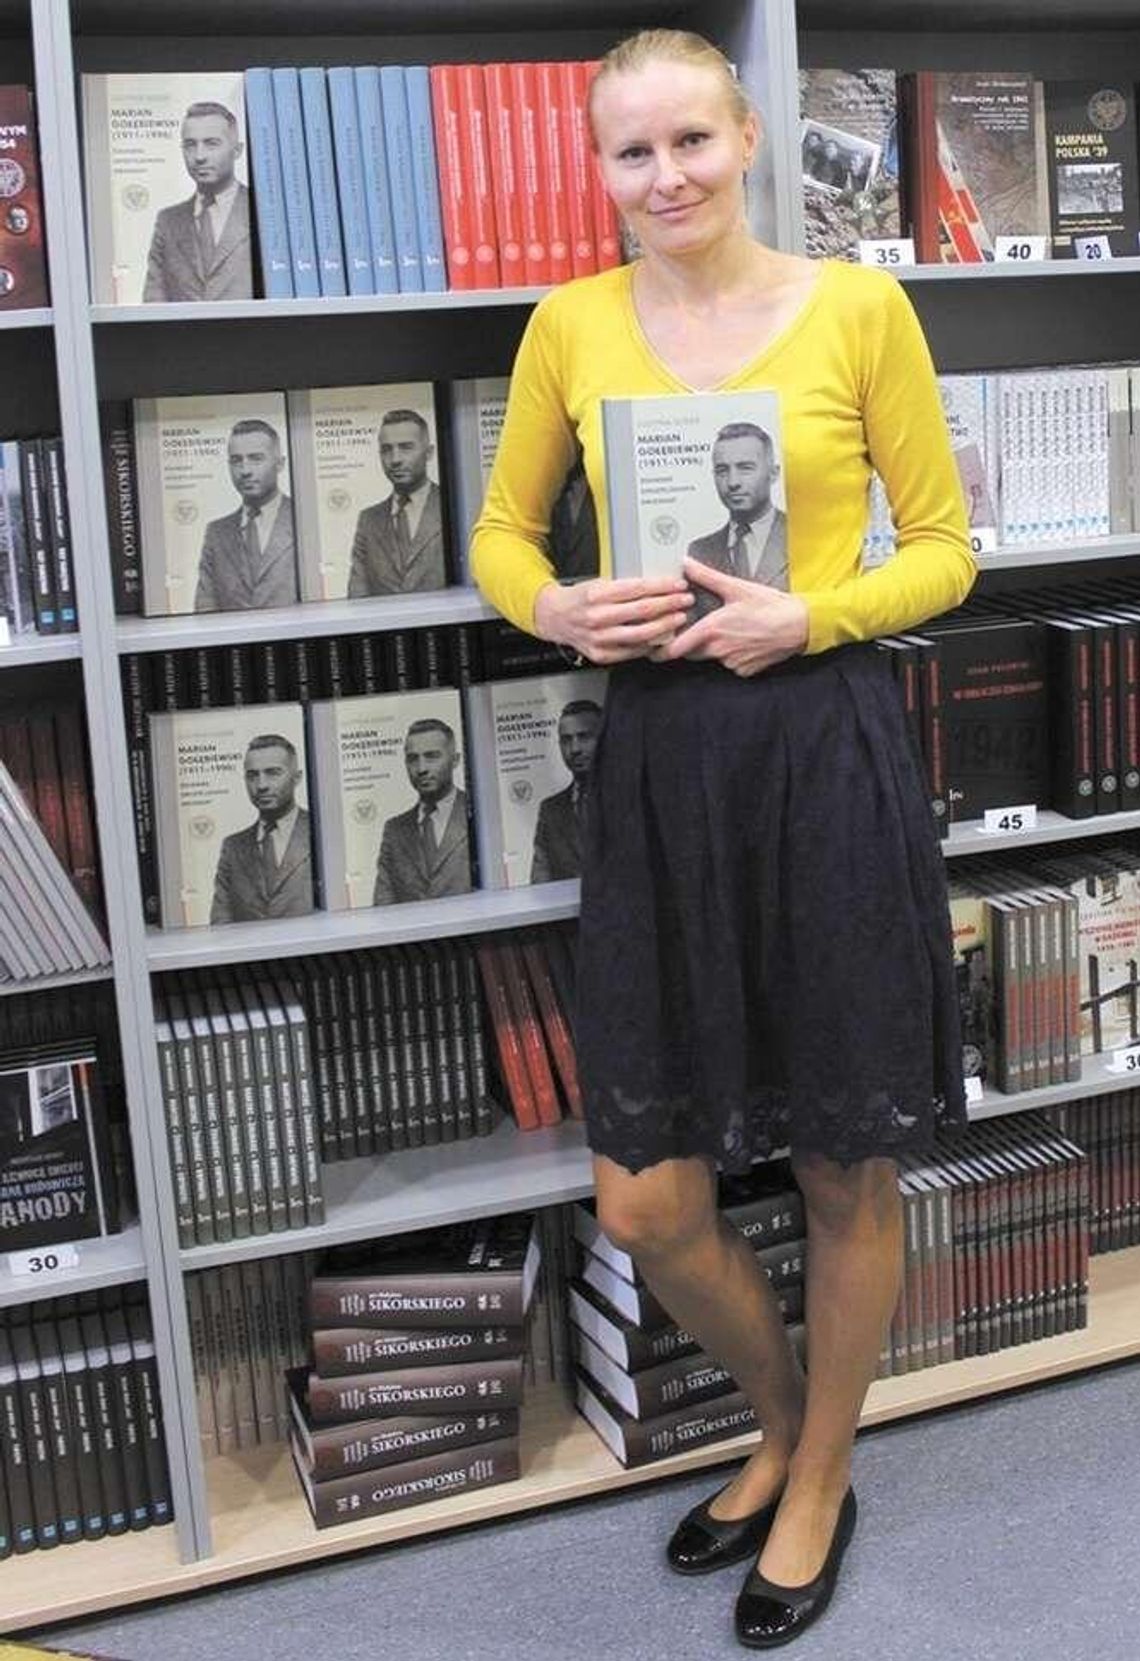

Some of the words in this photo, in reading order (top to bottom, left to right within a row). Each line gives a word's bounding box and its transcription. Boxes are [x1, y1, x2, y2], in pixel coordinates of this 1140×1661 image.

[1055, 133, 1104, 146] KAMPANIA
[1055, 146, 1092, 158] POLSKA
[875, 248, 901, 264] 35
[1006, 243, 1032, 260] 40
[1085, 243, 1102, 259] 20
[315, 418, 353, 427] MARIAN
[637, 433, 681, 443] MARIAN
[497, 711, 533, 722] MARIAN
[341, 730, 377, 740] MARIAN
[178, 744, 216, 753] MARIAN
[998, 814, 1023, 830] 45
[0, 1191, 86, 1229] ANODY
[28, 1254, 58, 1273] 30
[368, 1296, 467, 1311] SIKORSKIEGO
[374, 1333, 472, 1357] SIKORSKIEGO
[368, 1384, 466, 1404] SIKORSKIEGO
[371, 1421, 466, 1454] SIKORSKIEGO
